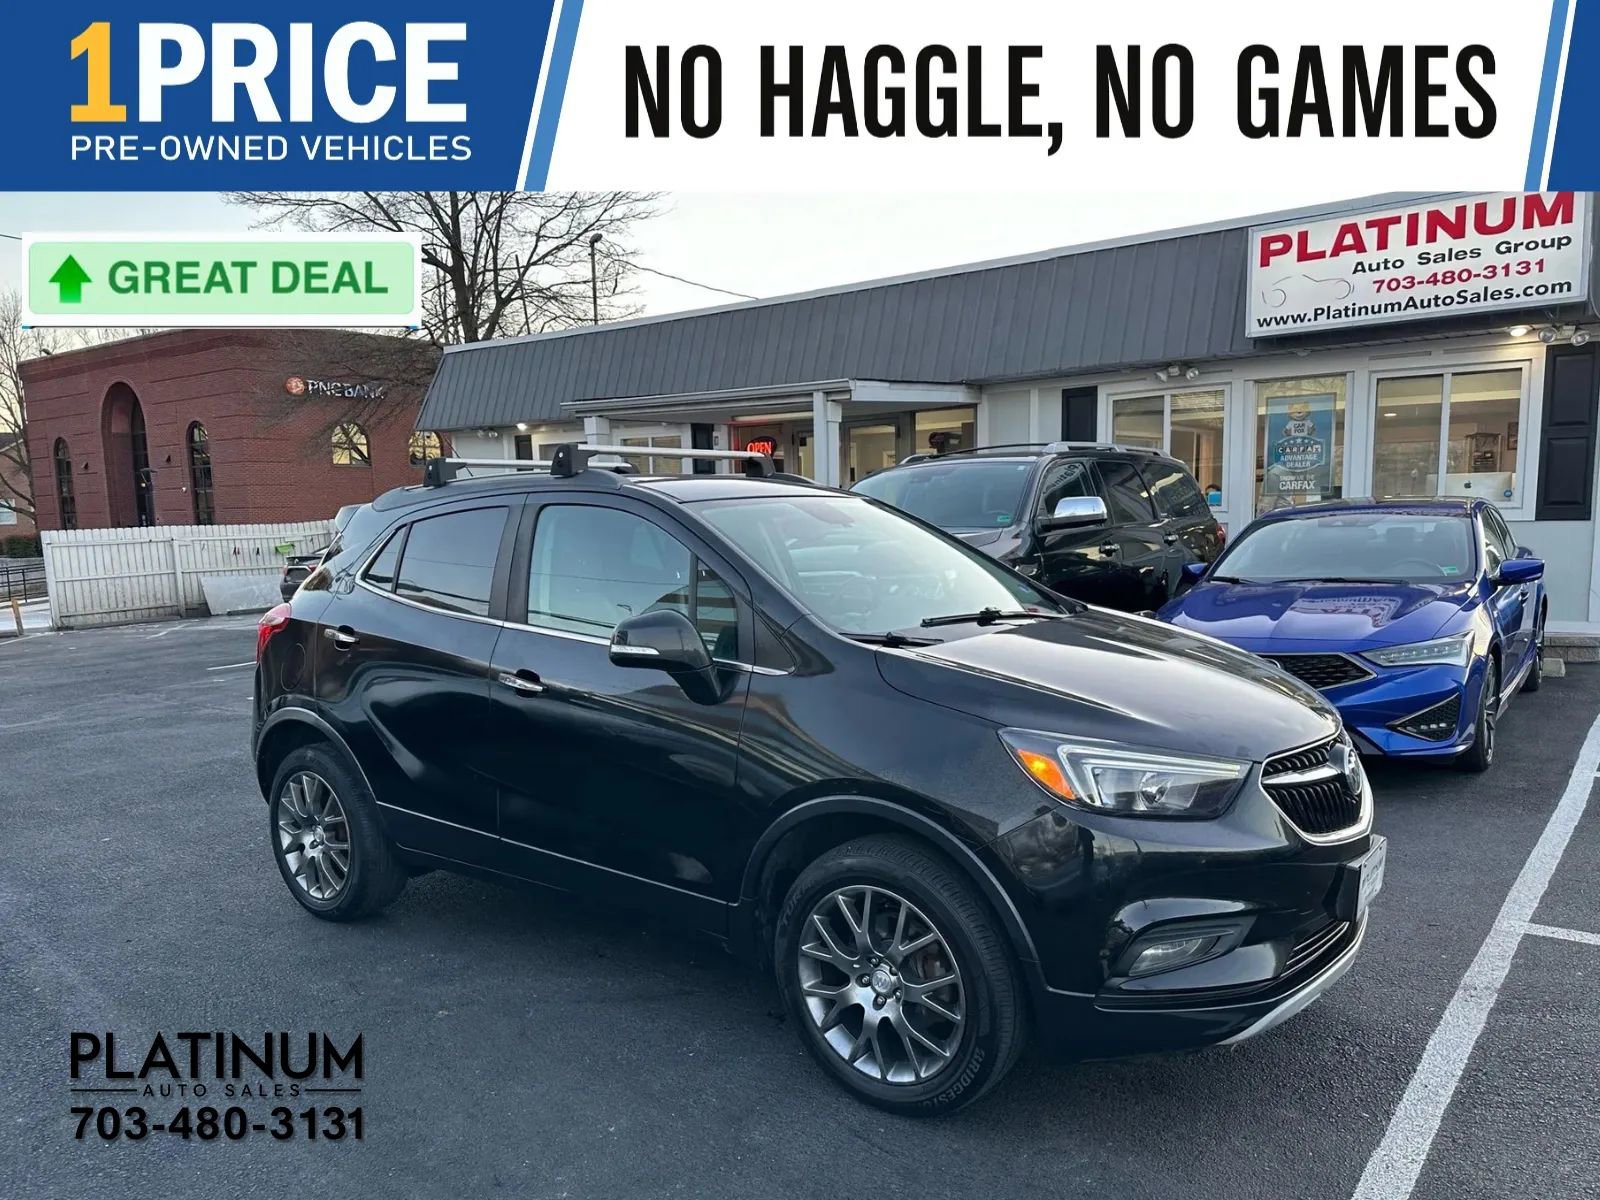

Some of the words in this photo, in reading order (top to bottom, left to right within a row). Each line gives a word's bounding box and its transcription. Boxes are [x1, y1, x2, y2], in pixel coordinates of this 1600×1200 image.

[1259, 191, 1575, 268] PLATINUM
[1351, 257, 1405, 275] Auto
[1416, 246, 1482, 266] Sales
[1494, 235, 1573, 256] Group
[1373, 258, 1545, 294] 703-480-3131
[1256, 281, 1573, 328] www.PlatinumAutoSales.com
[747, 441, 772, 454] OPEN
[1279, 481, 1316, 490] CARFAX
[917, 1046, 985, 1107] BRIDGES
